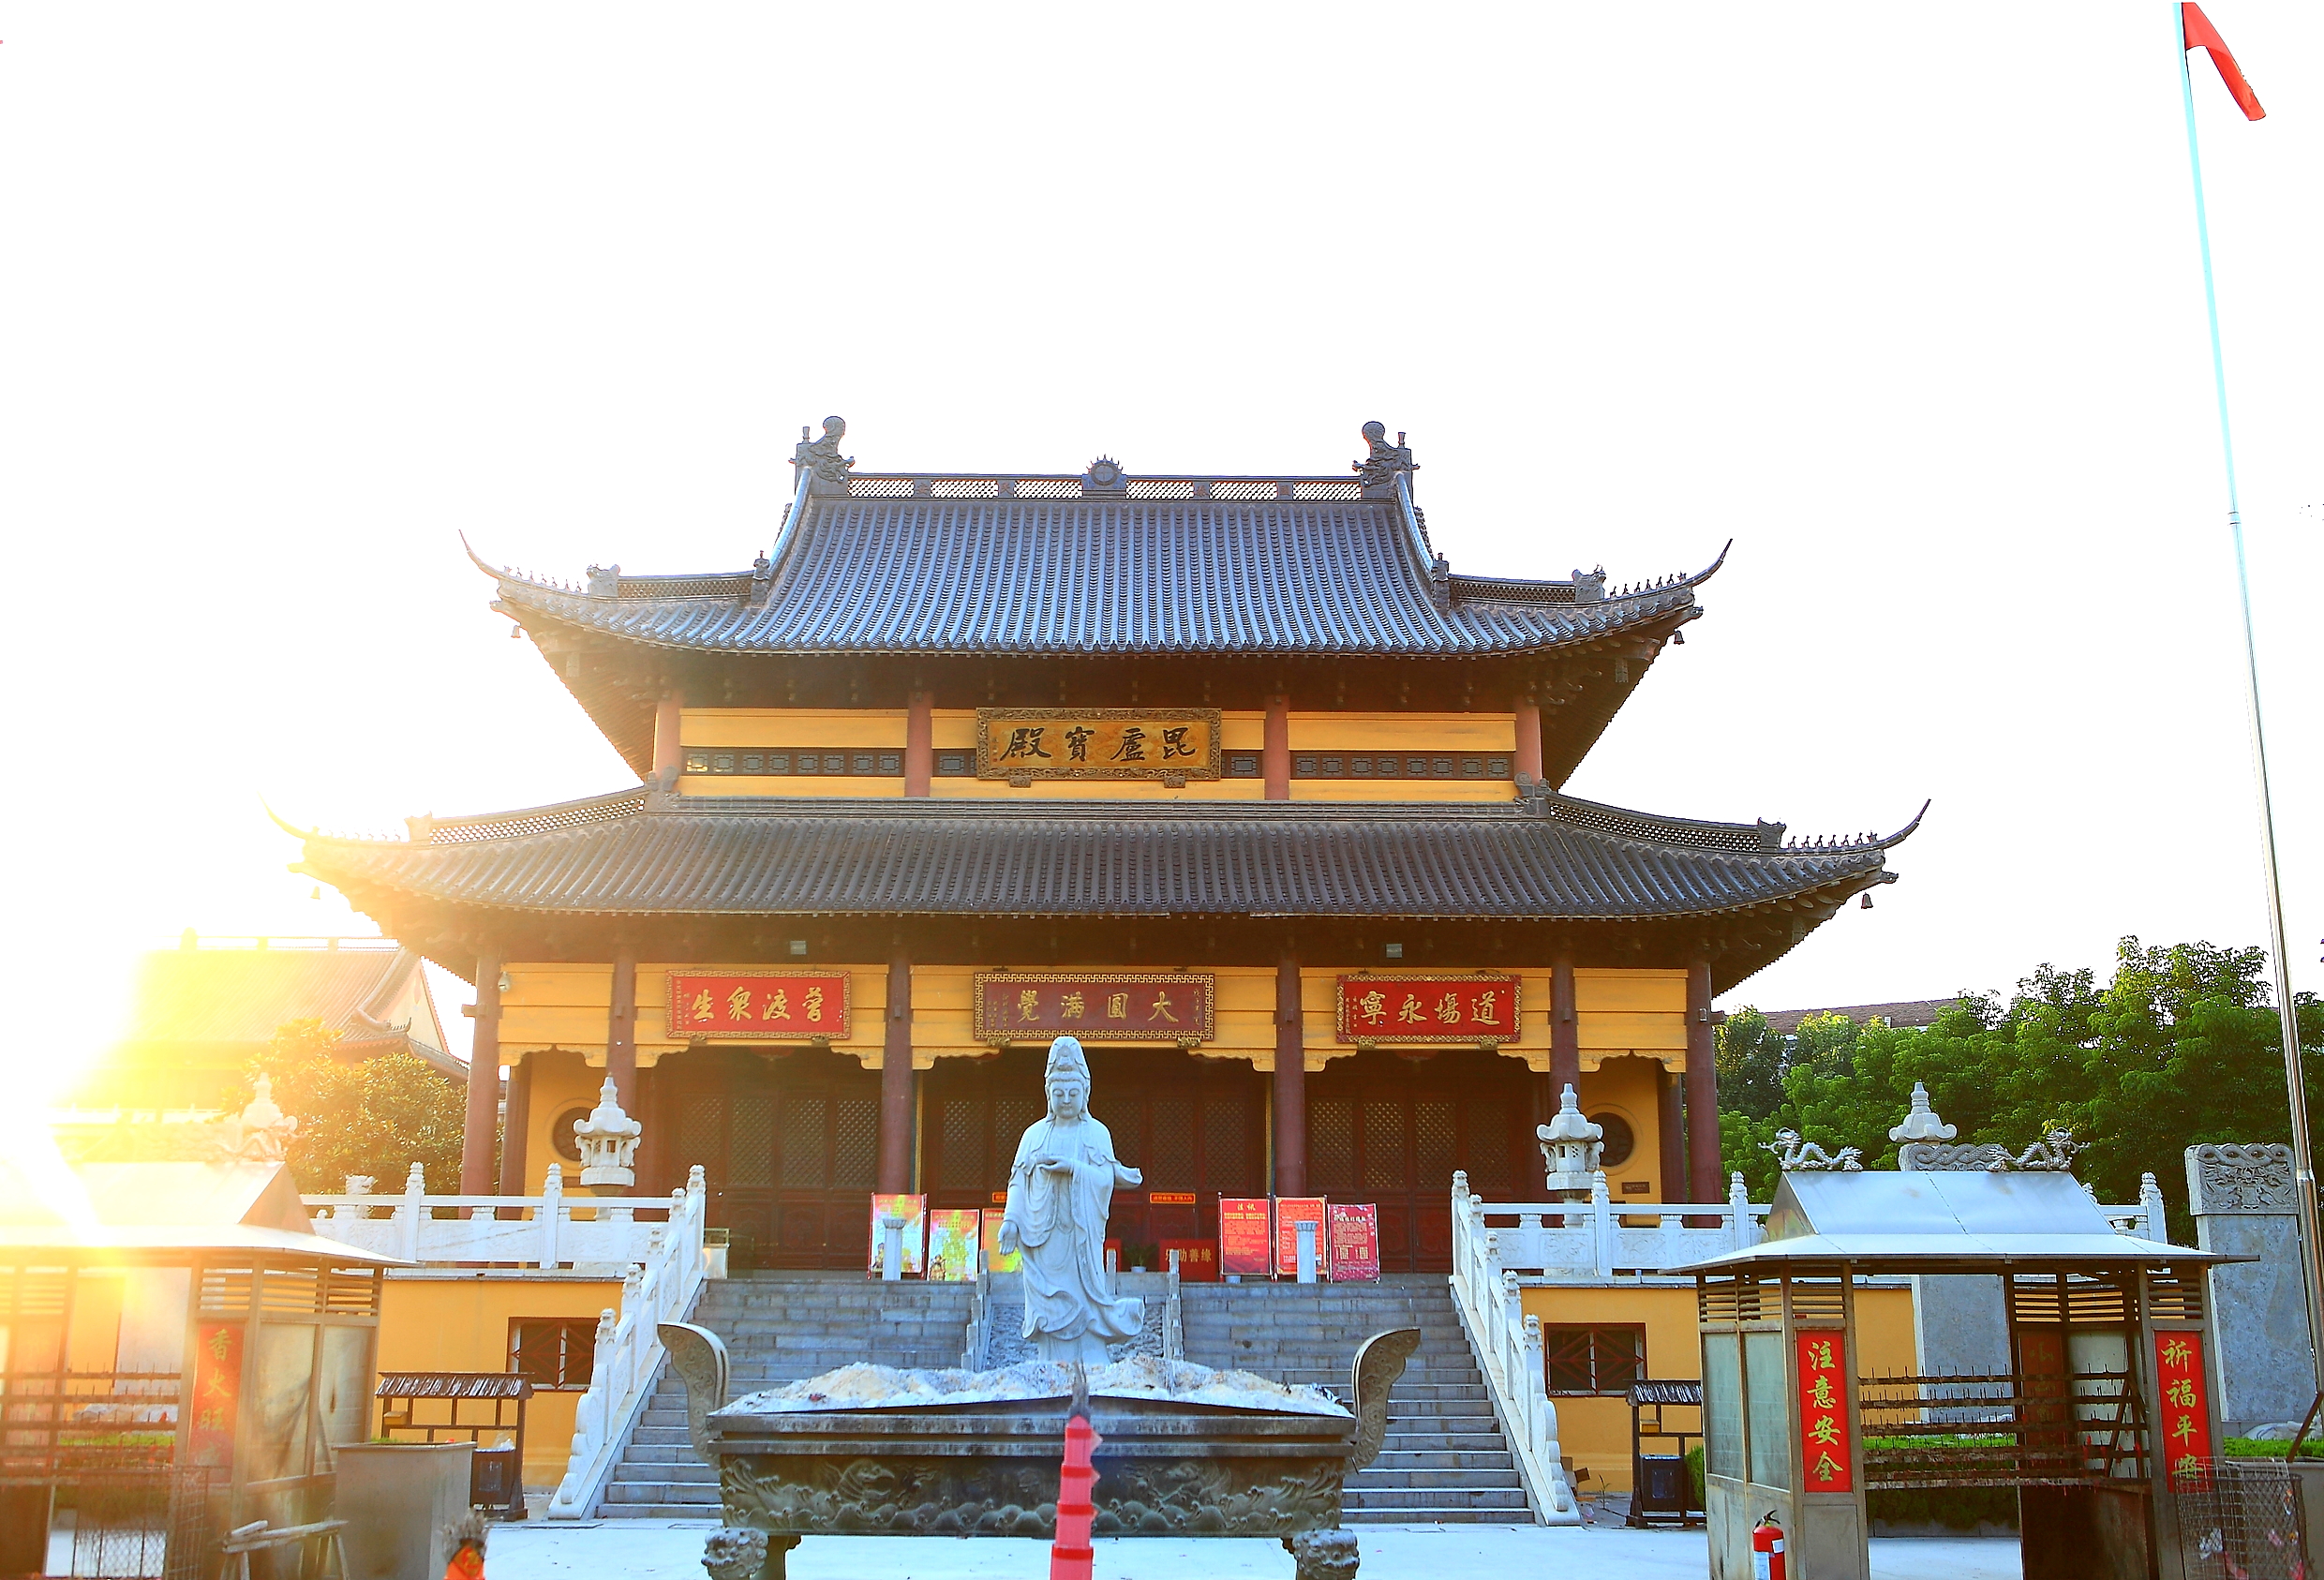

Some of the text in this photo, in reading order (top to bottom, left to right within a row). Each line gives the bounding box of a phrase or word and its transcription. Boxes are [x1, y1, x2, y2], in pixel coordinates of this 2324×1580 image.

[1807, 1340, 1844, 1482] 注意安全
[2161, 1339, 2204, 1482] 祈福平安
